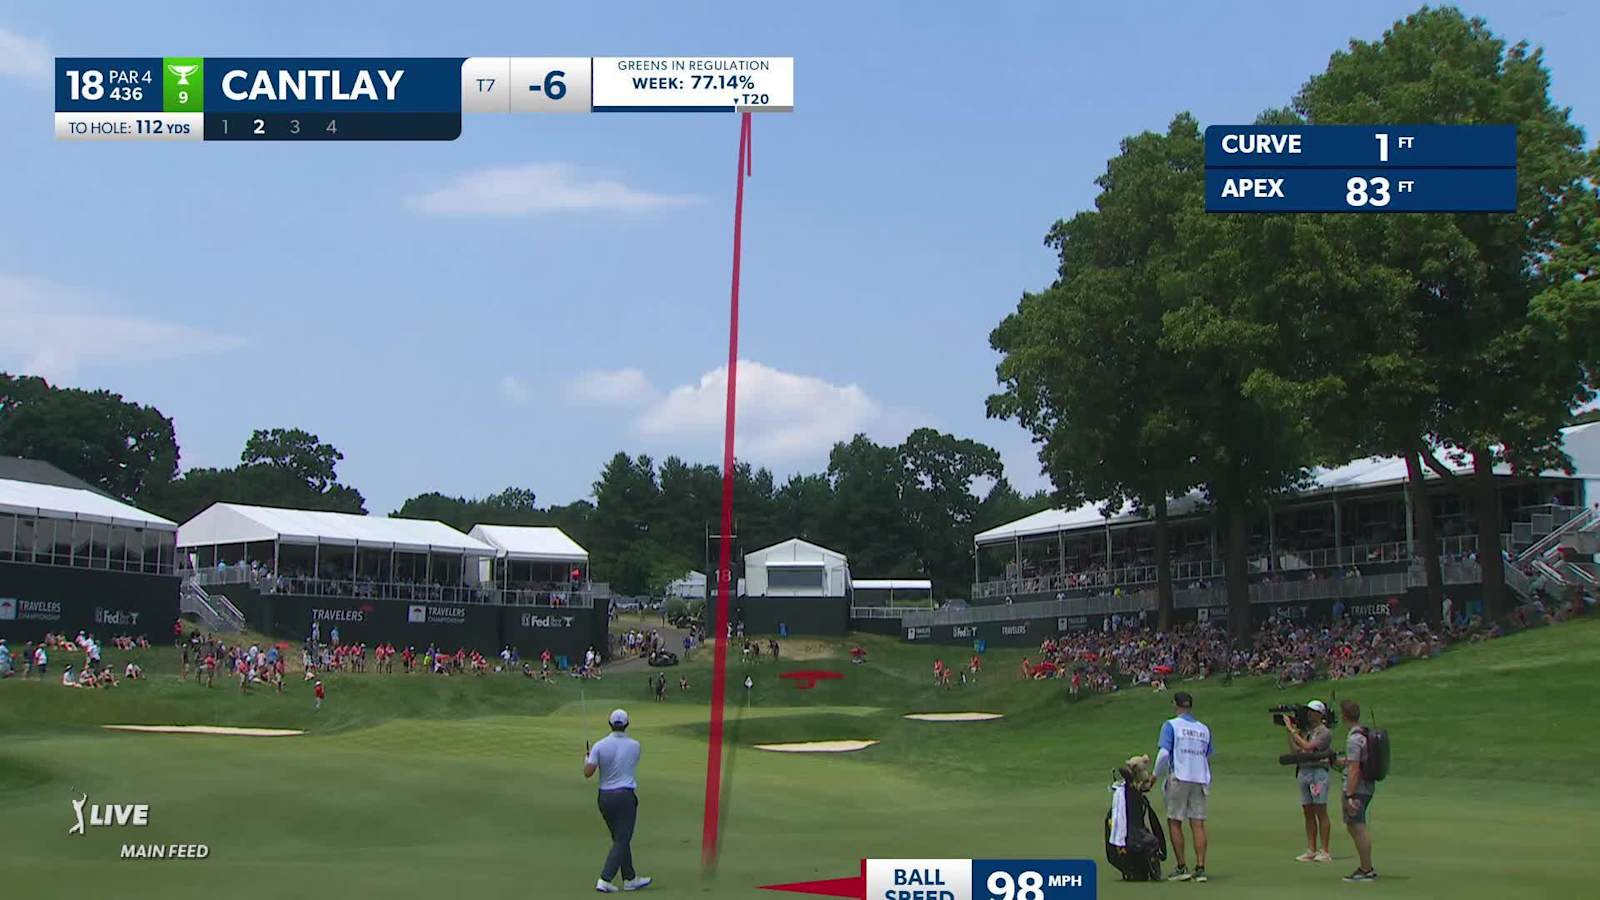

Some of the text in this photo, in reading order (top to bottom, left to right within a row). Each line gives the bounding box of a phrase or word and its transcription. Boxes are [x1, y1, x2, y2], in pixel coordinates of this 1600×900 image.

[715, 569, 731, 582] 18
[312, 609, 363, 621] TRAVELERS
[428, 606, 466, 617] TRAVELERS
[1350, 603, 1391, 617] TRAVELERS
